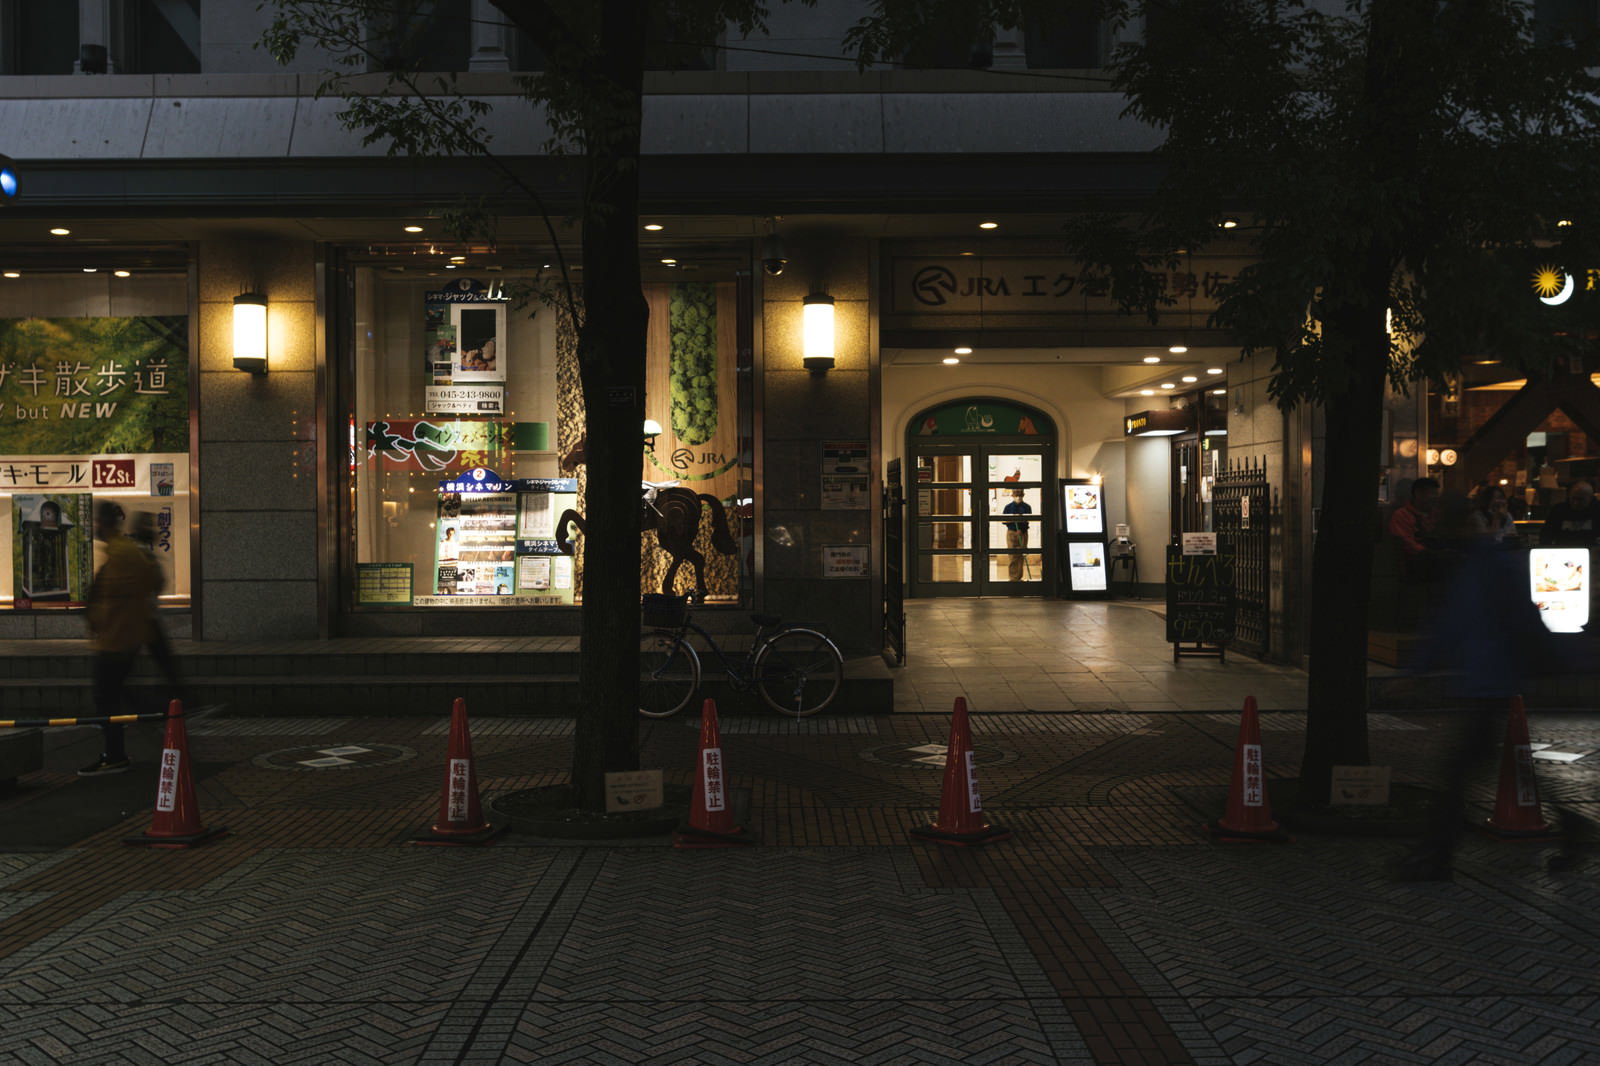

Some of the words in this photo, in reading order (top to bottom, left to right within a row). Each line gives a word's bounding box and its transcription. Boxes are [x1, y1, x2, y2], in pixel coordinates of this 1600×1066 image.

[960, 276, 1010, 297] JRA
[440, 390, 501, 399] 045-243-9800
[16, 404, 48, 419] but
[60, 402, 117, 418] NEW
[698, 453, 726, 465] JRA
[0, 463, 87, 486] キ・モール
[446, 482, 513, 492] 横浜シネマリン
[1168, 554, 1235, 585] せんべろ
[159, 753, 176, 808] 駐輪禁止
[706, 753, 722, 808] 駐輪禁止
[1247, 749, 1260, 803] 駐輪禁止
[451, 763, 465, 818] 駐輪禁止
